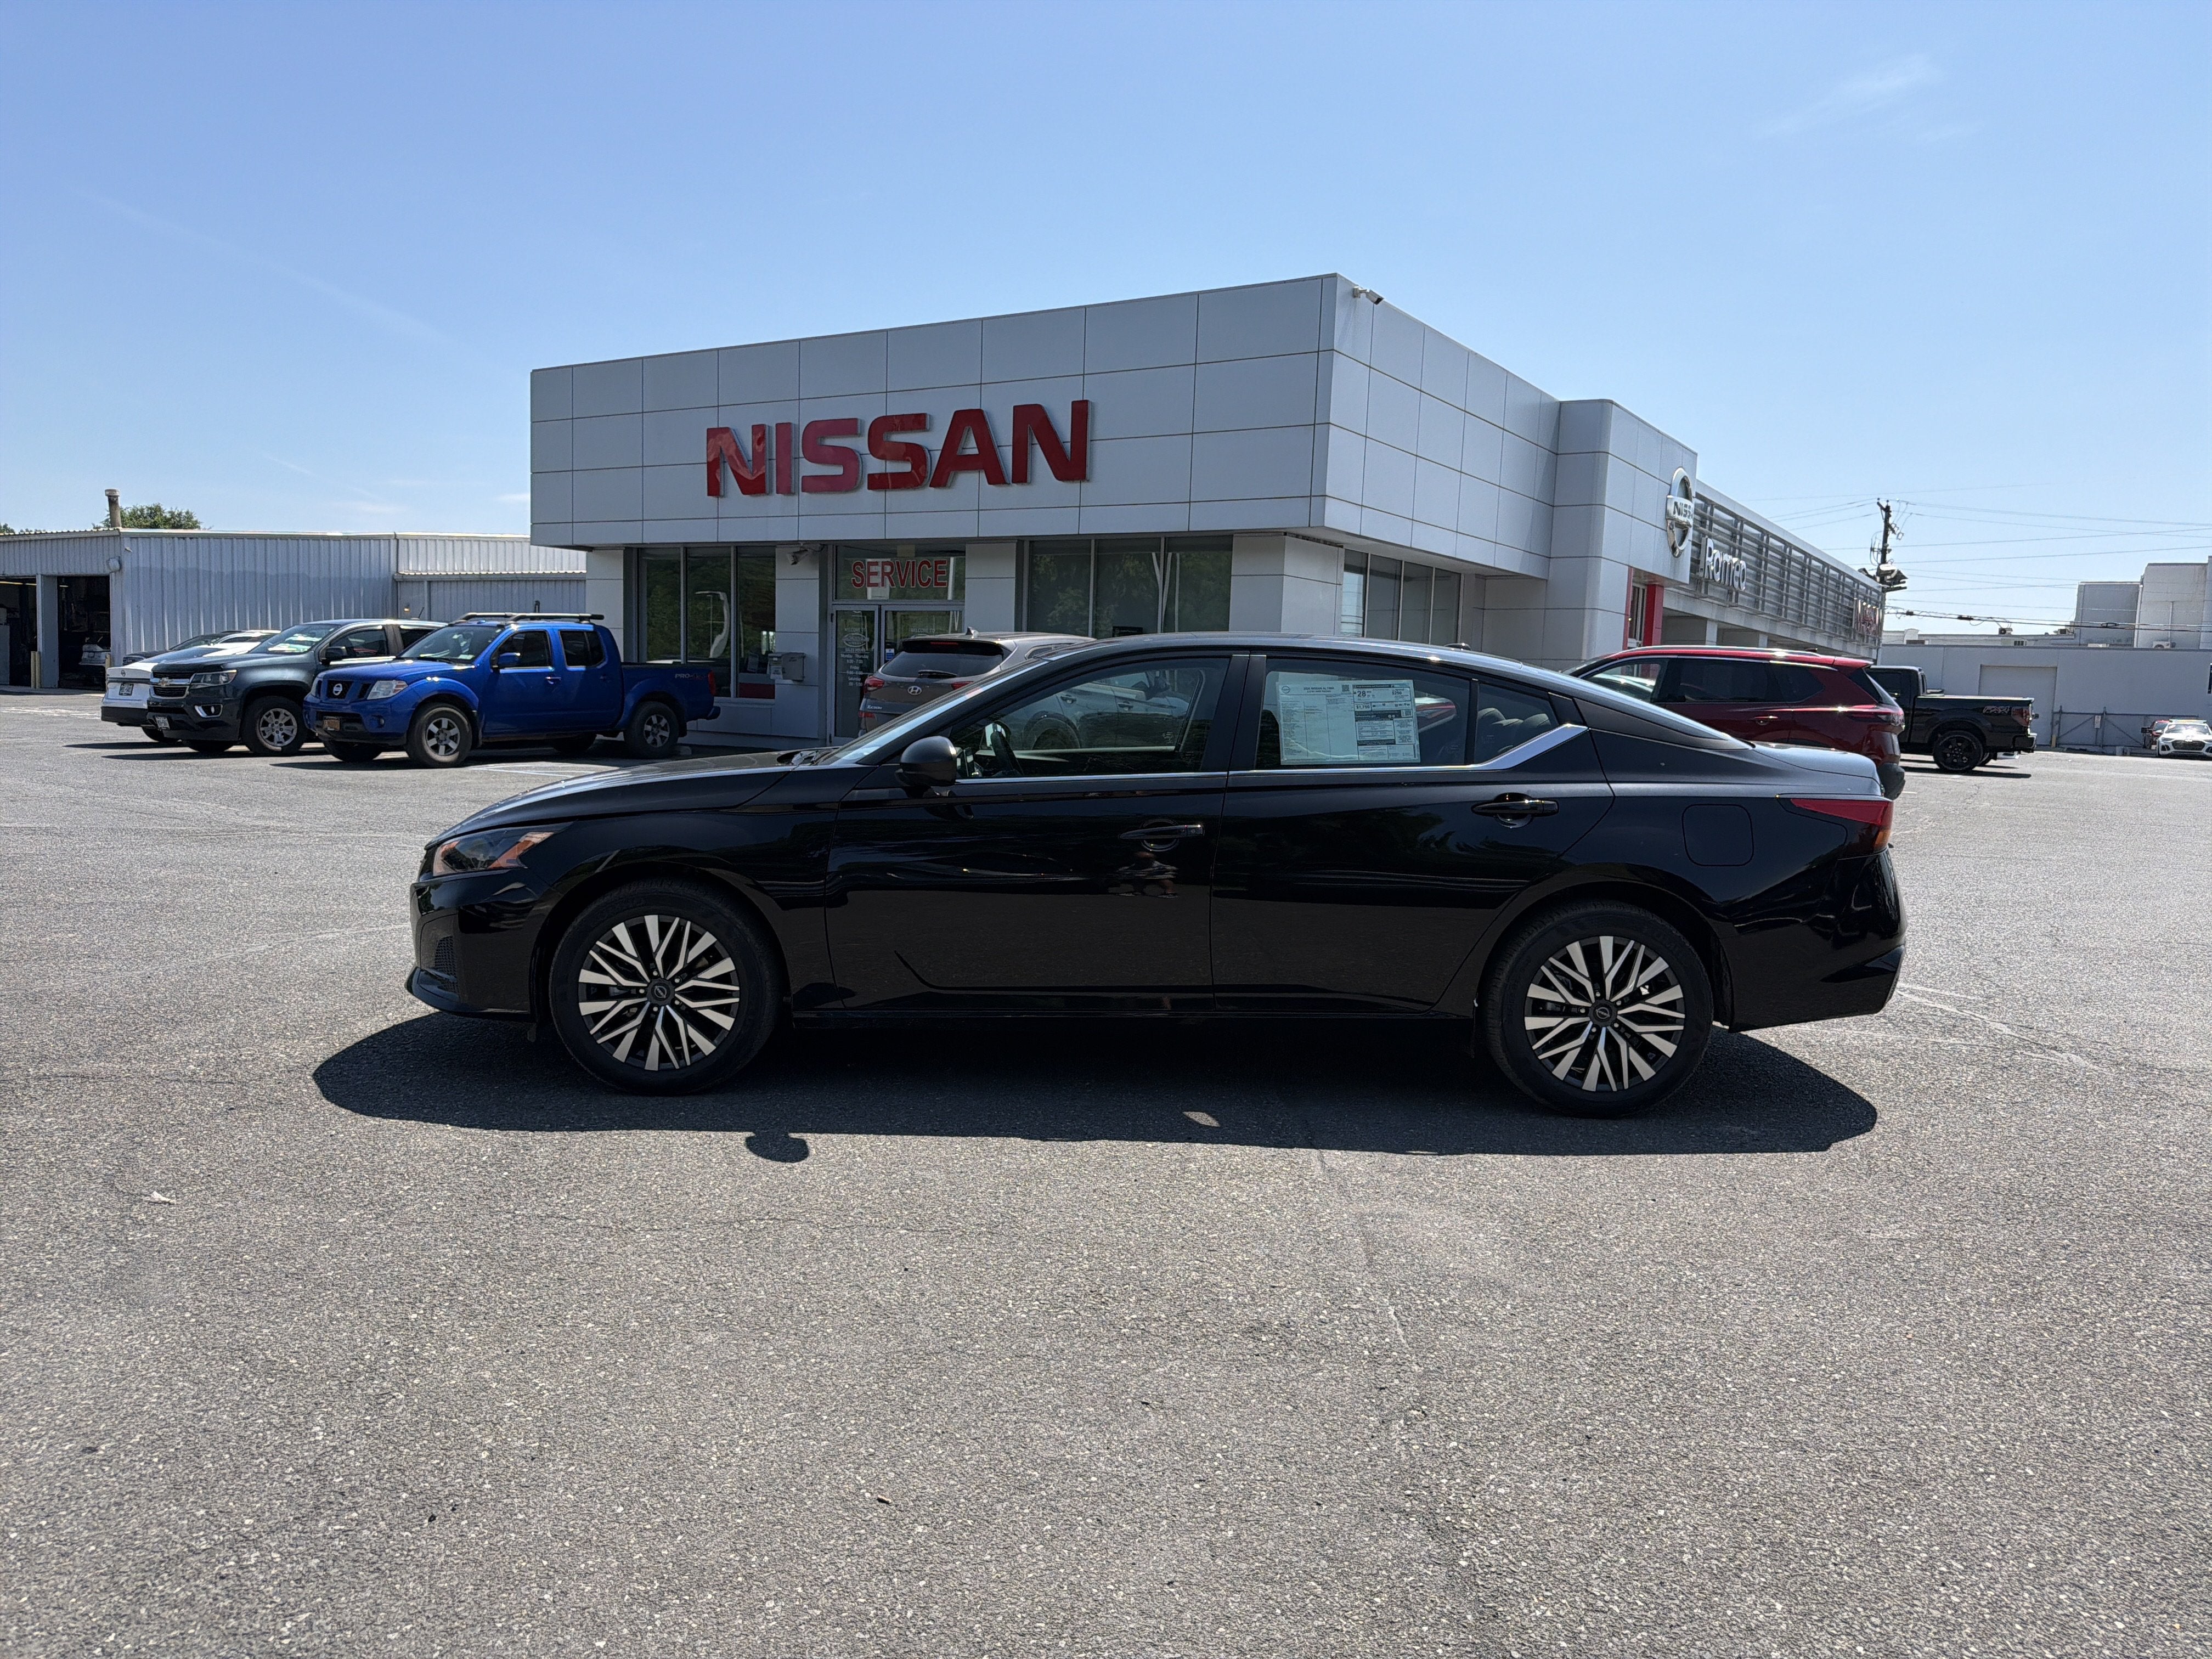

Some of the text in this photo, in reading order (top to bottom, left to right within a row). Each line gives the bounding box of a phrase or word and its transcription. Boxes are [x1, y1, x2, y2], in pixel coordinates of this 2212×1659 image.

[707, 399, 1092, 497] NISSAN
[1673, 501, 1693, 519] NISS
[851, 559, 948, 589] SERVICE
[1702, 537, 1747, 591] Romeo
